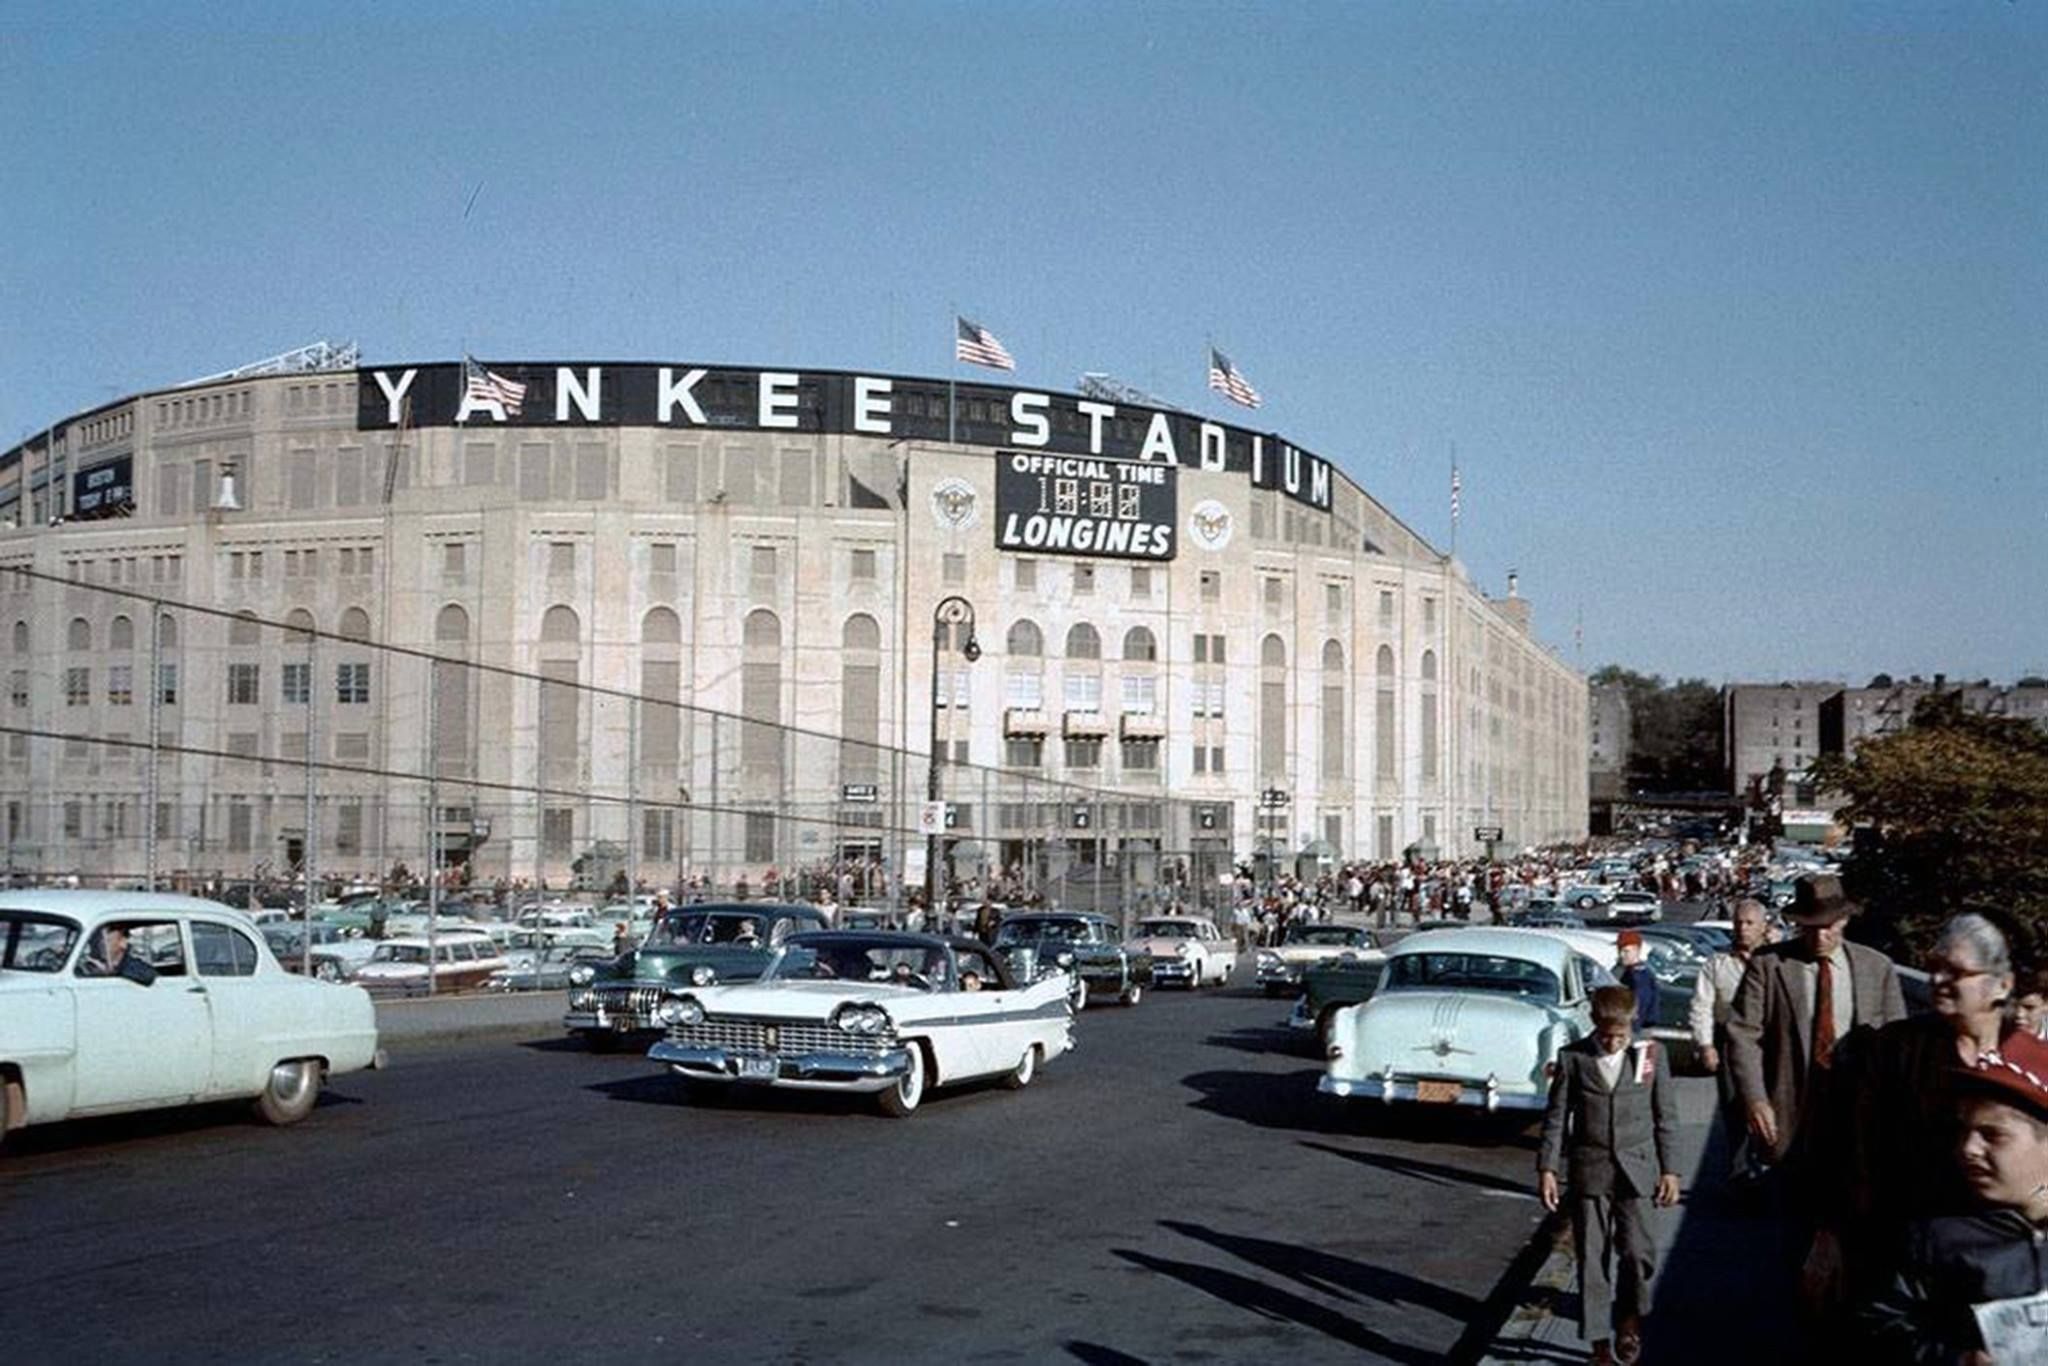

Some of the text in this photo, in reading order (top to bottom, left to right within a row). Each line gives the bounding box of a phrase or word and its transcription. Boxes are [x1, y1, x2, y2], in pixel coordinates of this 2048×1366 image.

[1010, 392, 1330, 507] STADIUM
[1012, 454, 1166, 485] OFFICIAL TIME
[1002, 512, 1172, 556] LONGINES
